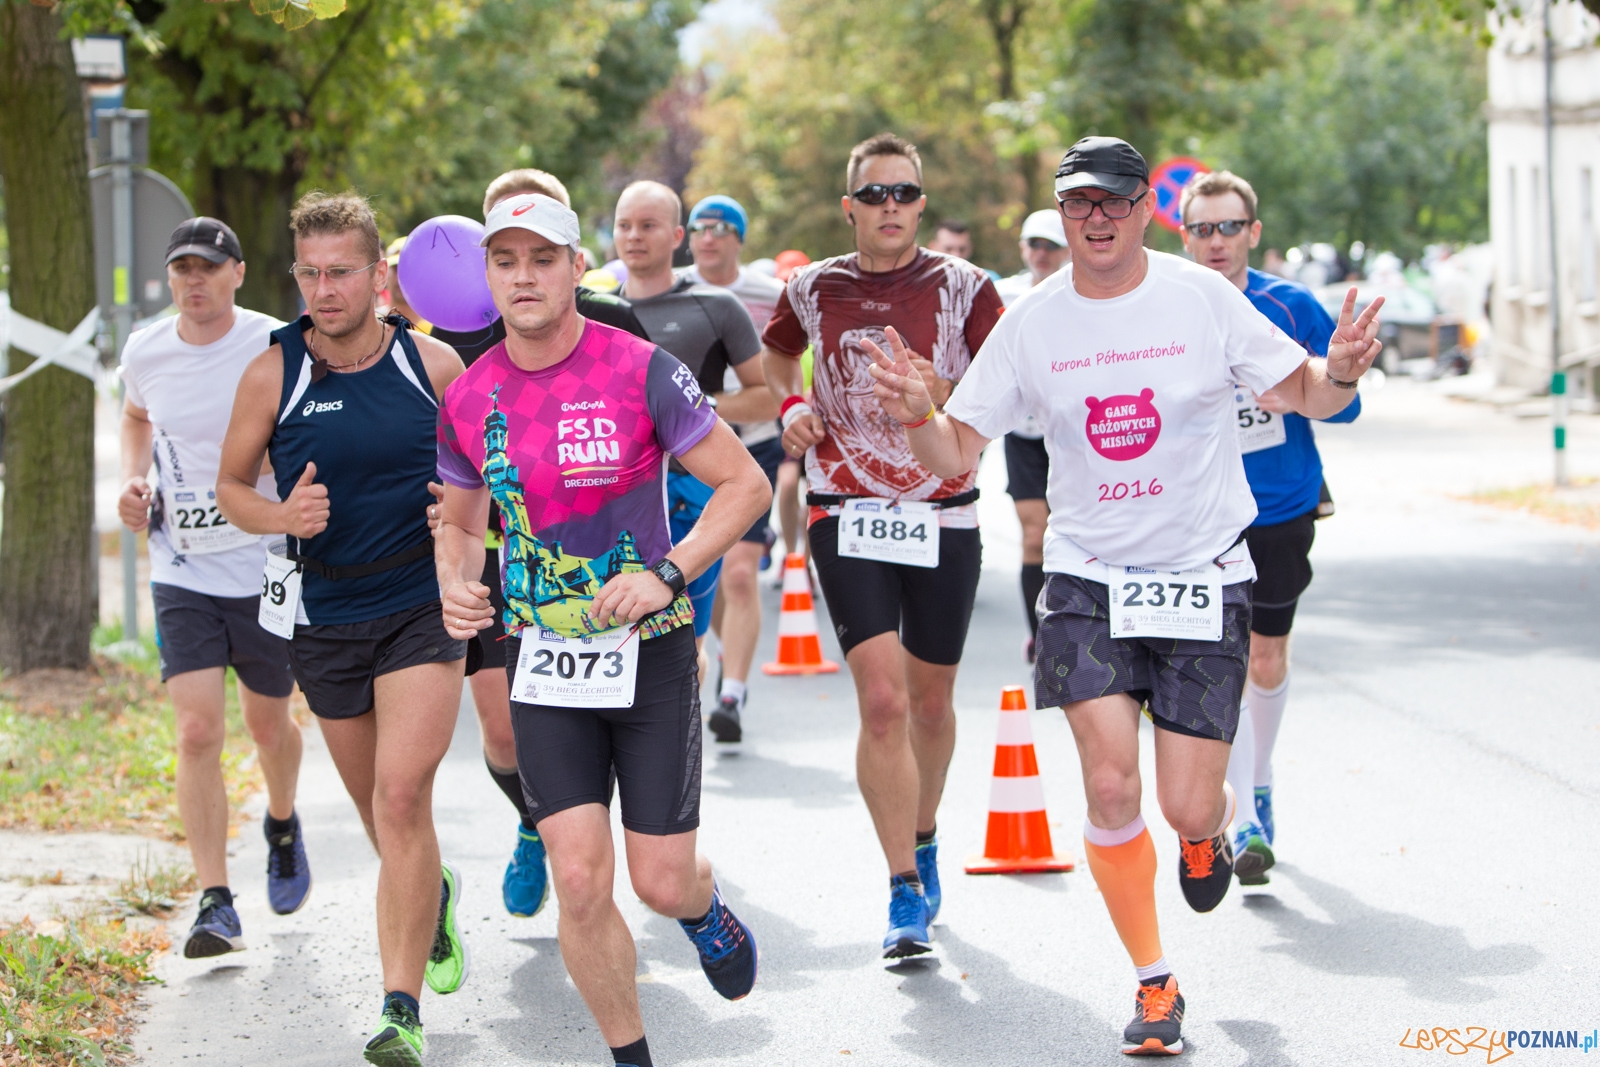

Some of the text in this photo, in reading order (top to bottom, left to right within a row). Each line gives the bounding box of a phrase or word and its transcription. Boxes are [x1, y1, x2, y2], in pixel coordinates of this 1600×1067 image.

[1051, 341, 1186, 374] Korona Półmaratonów
[671, 363, 693, 389] FS
[1105, 404, 1137, 419] GANG
[558, 417, 617, 441] FSD
[1090, 416, 1157, 435] RÓŻOWYCH
[1101, 431, 1147, 449] MISIÓW
[557, 440, 620, 466] RUN
[564, 476, 619, 488] DREZDENKO
[1098, 478, 1164, 502] 2016
[852, 517, 927, 542] 1884
[1123, 582, 1210, 609] 2375
[1150, 615, 1170, 623] BIEG
[1172, 615, 1213, 626] LECHITÓW
[530, 649, 623, 679] 2073
[543, 684, 624, 694] 39 BIEG LECHITÓW
